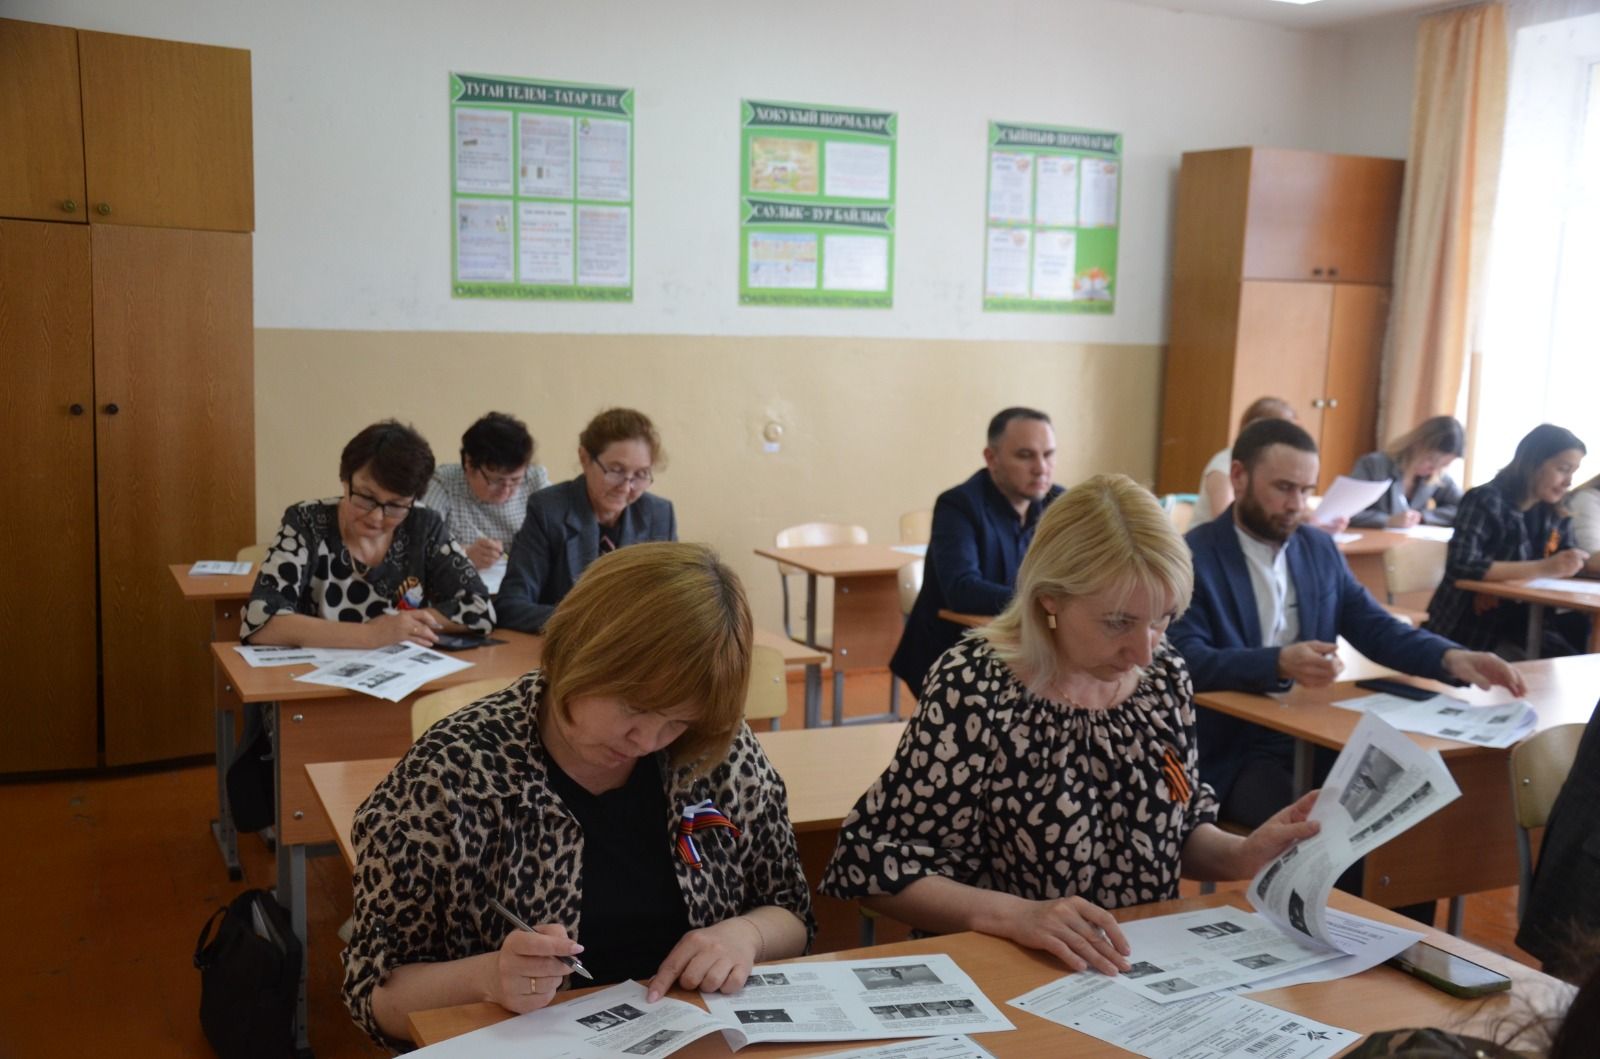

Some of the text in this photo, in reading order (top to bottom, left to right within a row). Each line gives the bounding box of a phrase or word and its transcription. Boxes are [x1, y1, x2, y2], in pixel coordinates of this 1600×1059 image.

[466, 82, 504, 97] ТУГАН
[508, 86, 547, 100] ТЕЛЕМ
[555, 90, 588, 104] ТАТАР
[591, 93, 618, 107] ТЕЛЕ
[752, 204, 805, 219] САУЛЫК
